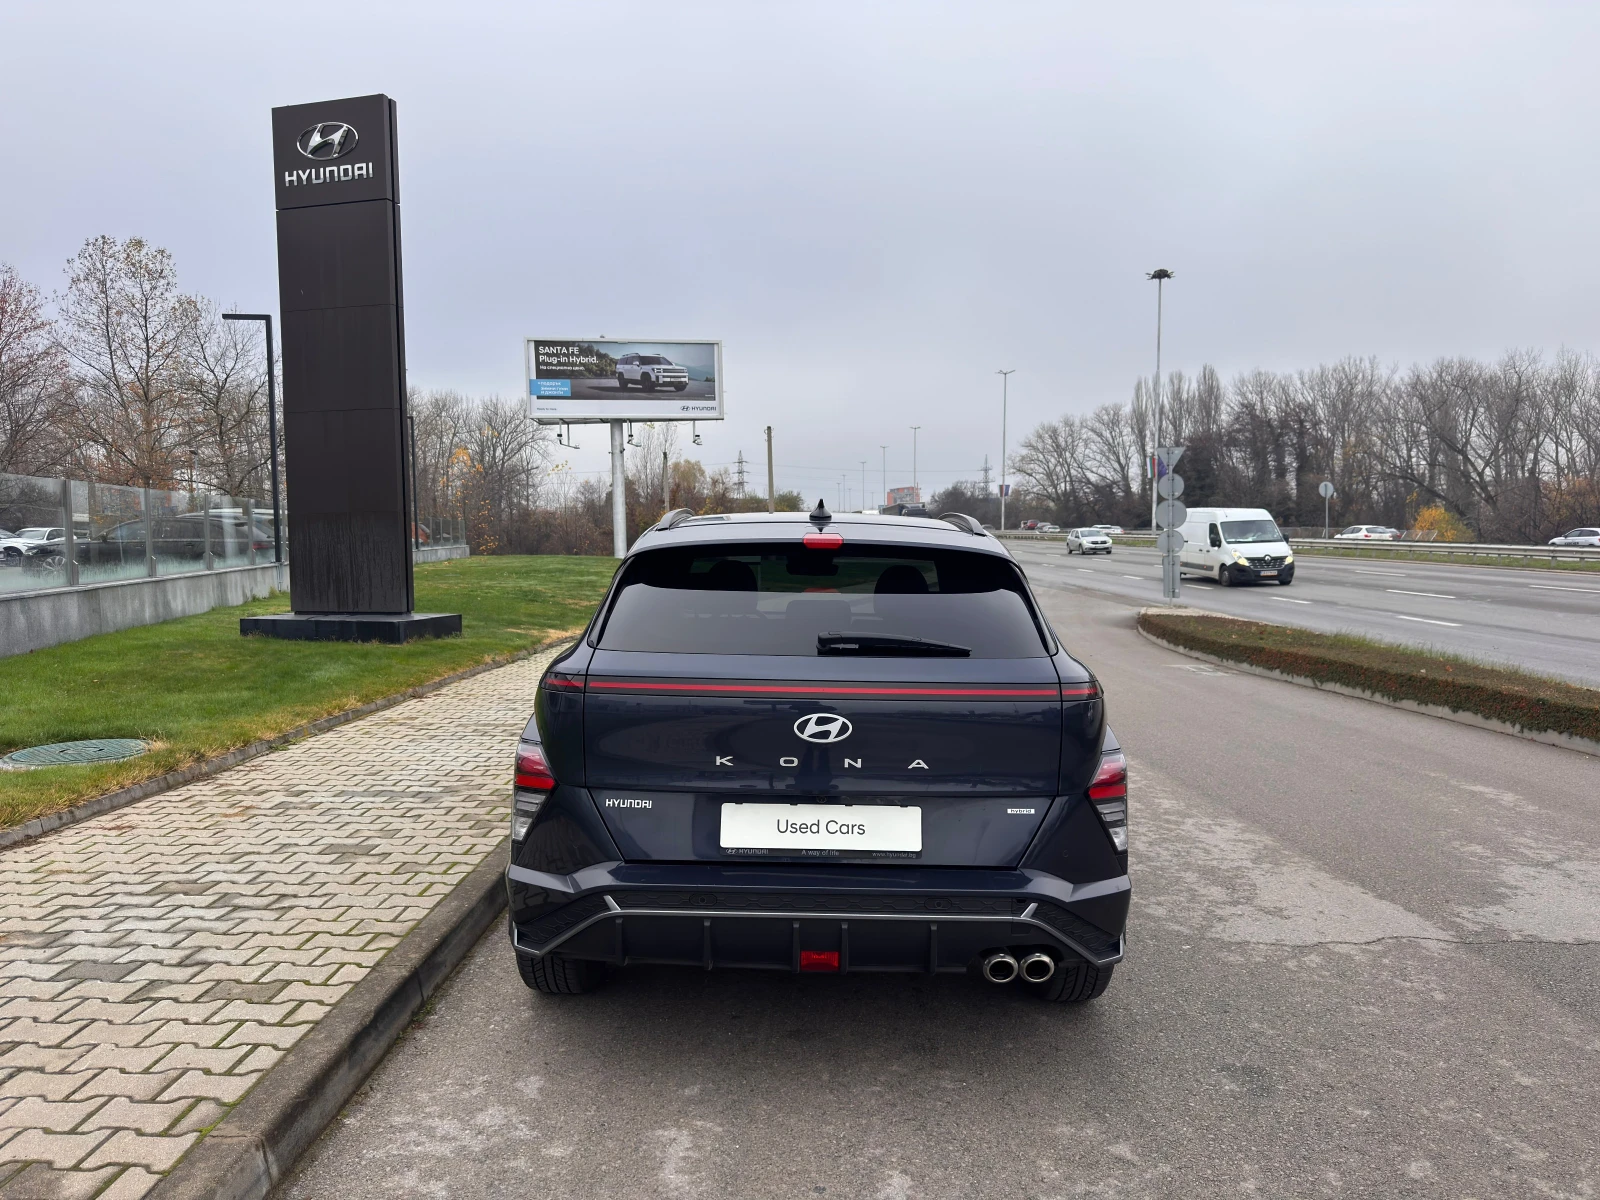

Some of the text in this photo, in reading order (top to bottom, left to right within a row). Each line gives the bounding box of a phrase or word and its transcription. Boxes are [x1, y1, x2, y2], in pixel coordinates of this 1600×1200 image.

[284, 162, 373, 187] HYUNDAI
[538, 346, 580, 355] SANTA FE
[539, 355, 599, 365] Plug-in Hybrid.
[605, 798, 653, 809] HYUNDAI
[776, 818, 866, 836] Used Cars
